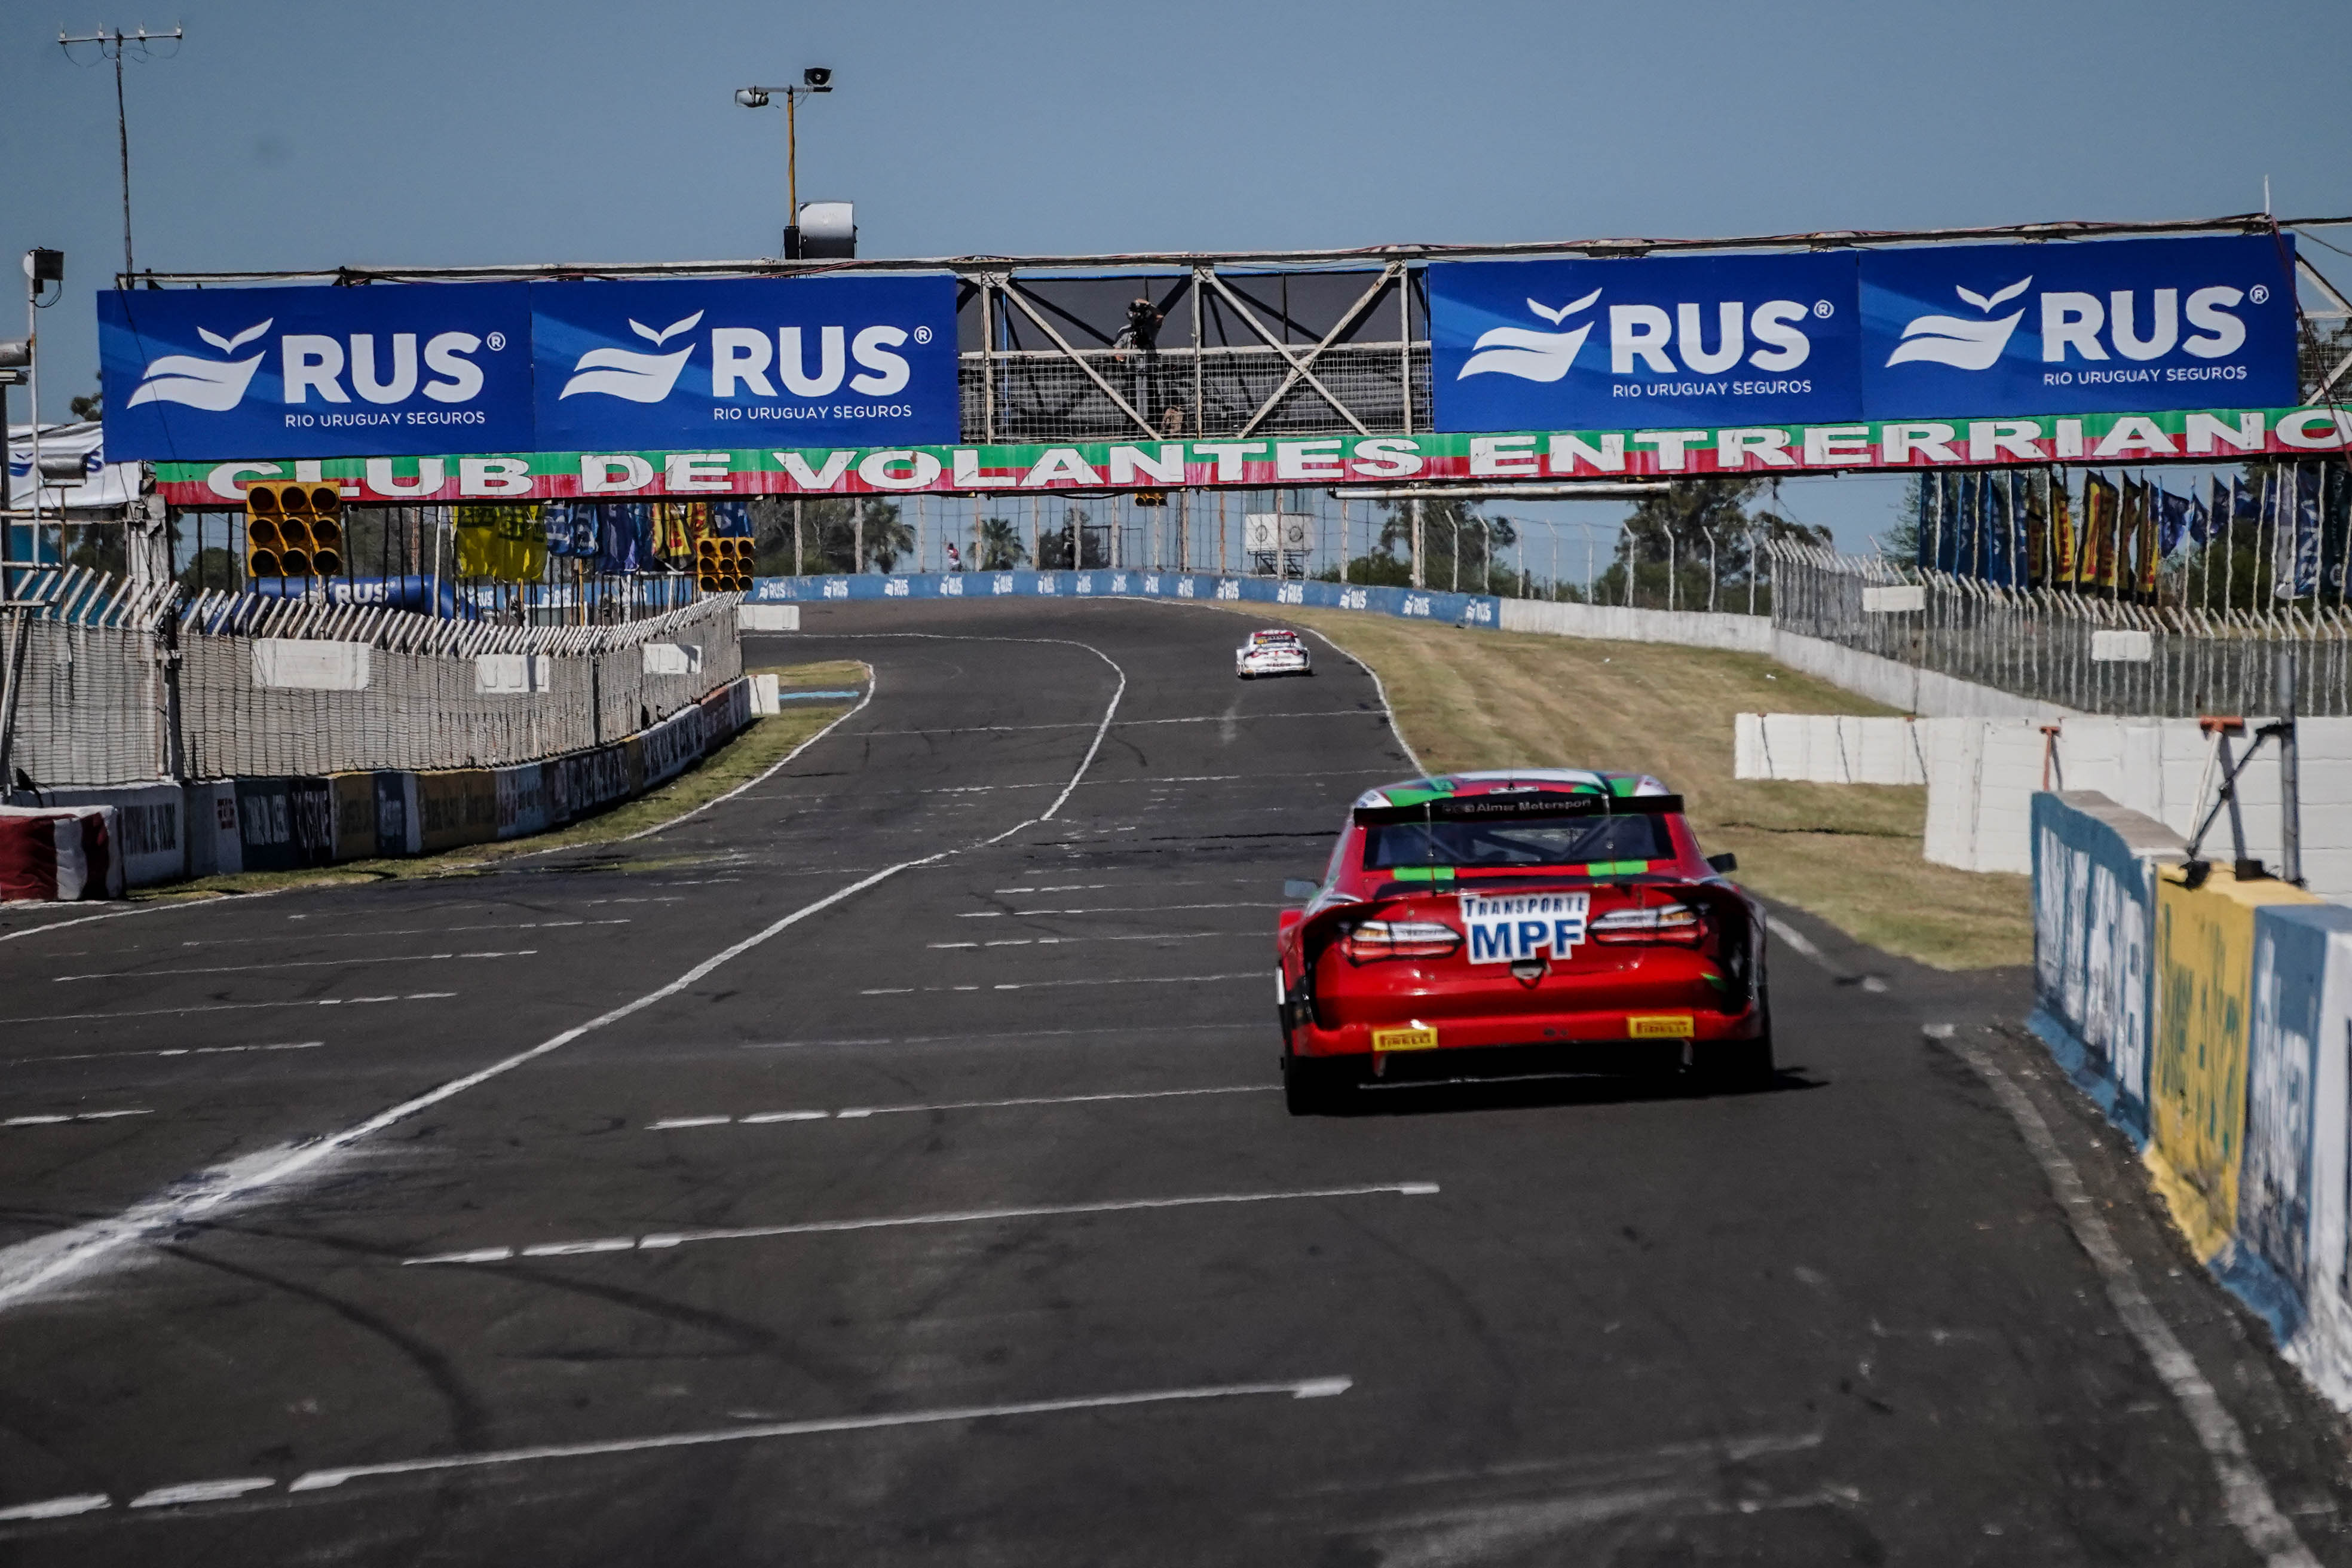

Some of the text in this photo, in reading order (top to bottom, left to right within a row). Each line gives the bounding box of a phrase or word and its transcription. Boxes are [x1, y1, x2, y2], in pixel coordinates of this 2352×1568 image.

[2044, 366, 2247, 385] RIO URUGUAY SEGUROS
[1613, 379, 1812, 398] RIO URUGUAY SEGUROS
[286, 411, 485, 427] RIO URUGUAY SEGUROS
[714, 405, 912, 420] RIO URUGUAY SEGUROS
[207, 409, 2352, 500] CLUB DE VOLANTES ENTRERRIANO
[1472, 919, 1581, 959] MPF
